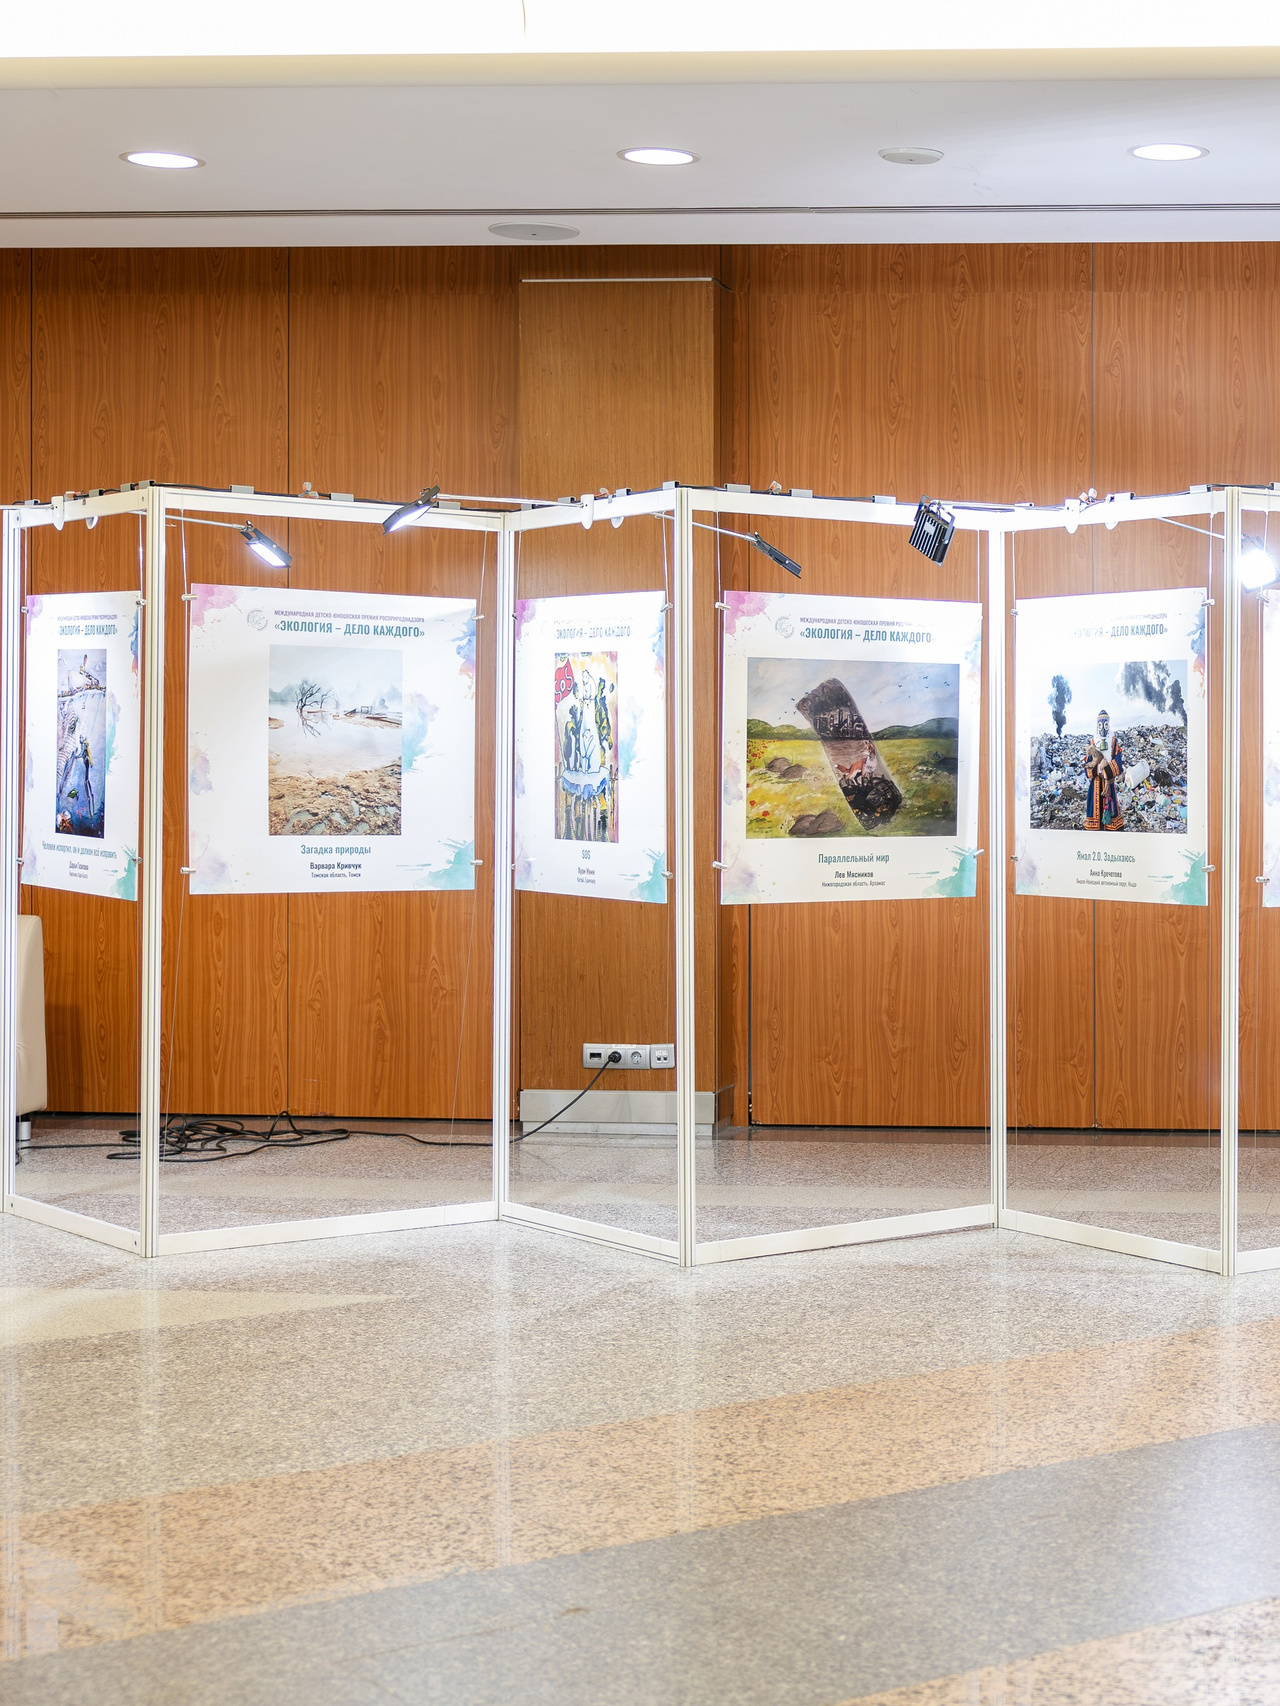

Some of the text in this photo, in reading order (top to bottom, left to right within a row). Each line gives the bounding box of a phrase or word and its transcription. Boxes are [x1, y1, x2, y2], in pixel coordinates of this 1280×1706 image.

[274, 609, 314, 618] МЕЖДУНАРОДНАЯ
[379, 615, 425, 623] РОСПРИРОДНАДЗОРА
[800, 617, 836, 625] МЕЖДУНАРОДНАЯ
[274, 620, 332, 634] «ЭКОЛОГИЯ
[344, 623, 370, 636] ДЕЛО
[373, 625, 425, 639] КАЖДОГО»
[800, 627, 853, 640] «ЭКОЛОГИЯ
[863, 630, 887, 643] ДЕЛО
[1111, 625, 1129, 638] ДЕЛО
[1131, 623, 1168, 637] КАЖДОГО»
[300, 844, 371, 856] Загадка природы
[581, 849, 591, 860] SOS
[818, 853, 890, 865] Параллельный мир
[1076, 850, 1091, 861] Ямал
[1103, 852, 1136, 863] Задыхаюсь
[310, 862, 335, 871] Варвара
[834, 870, 873, 879] Лев Мясников
